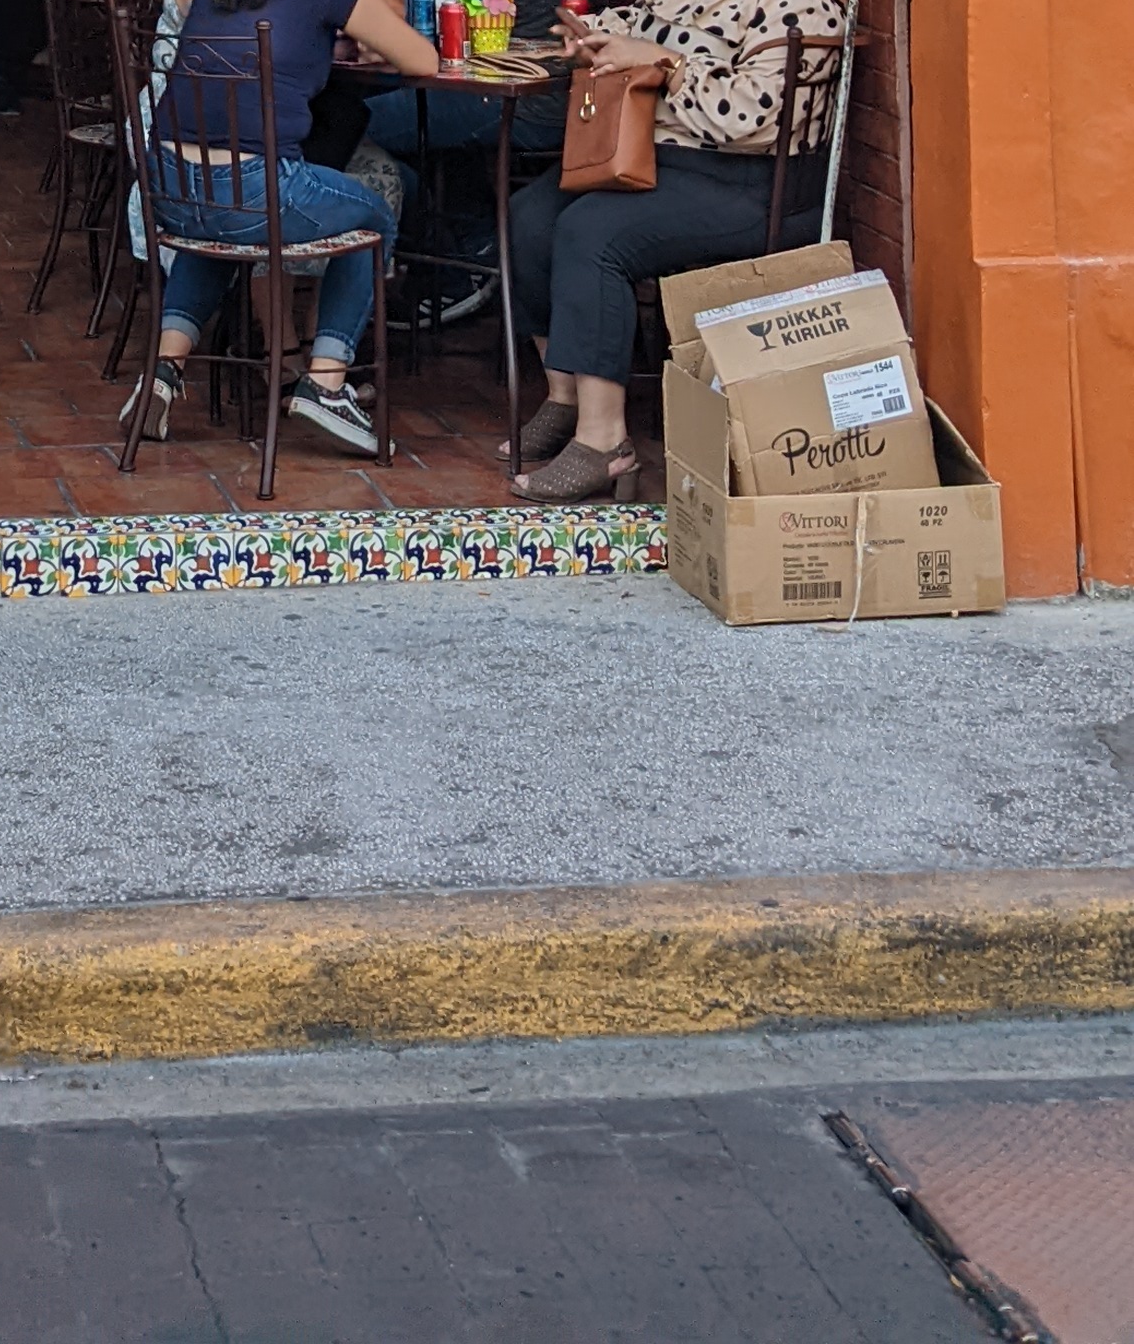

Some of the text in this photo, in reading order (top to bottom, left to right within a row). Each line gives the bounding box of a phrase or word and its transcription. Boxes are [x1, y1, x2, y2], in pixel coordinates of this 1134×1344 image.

[775, 301, 843, 330] DİKKAT
[780, 317, 850, 347] KIRILIR
[771, 424, 886, 477] Perotti
[789, 512, 848, 529] VITTORI
[919, 505, 948, 517] 1020
